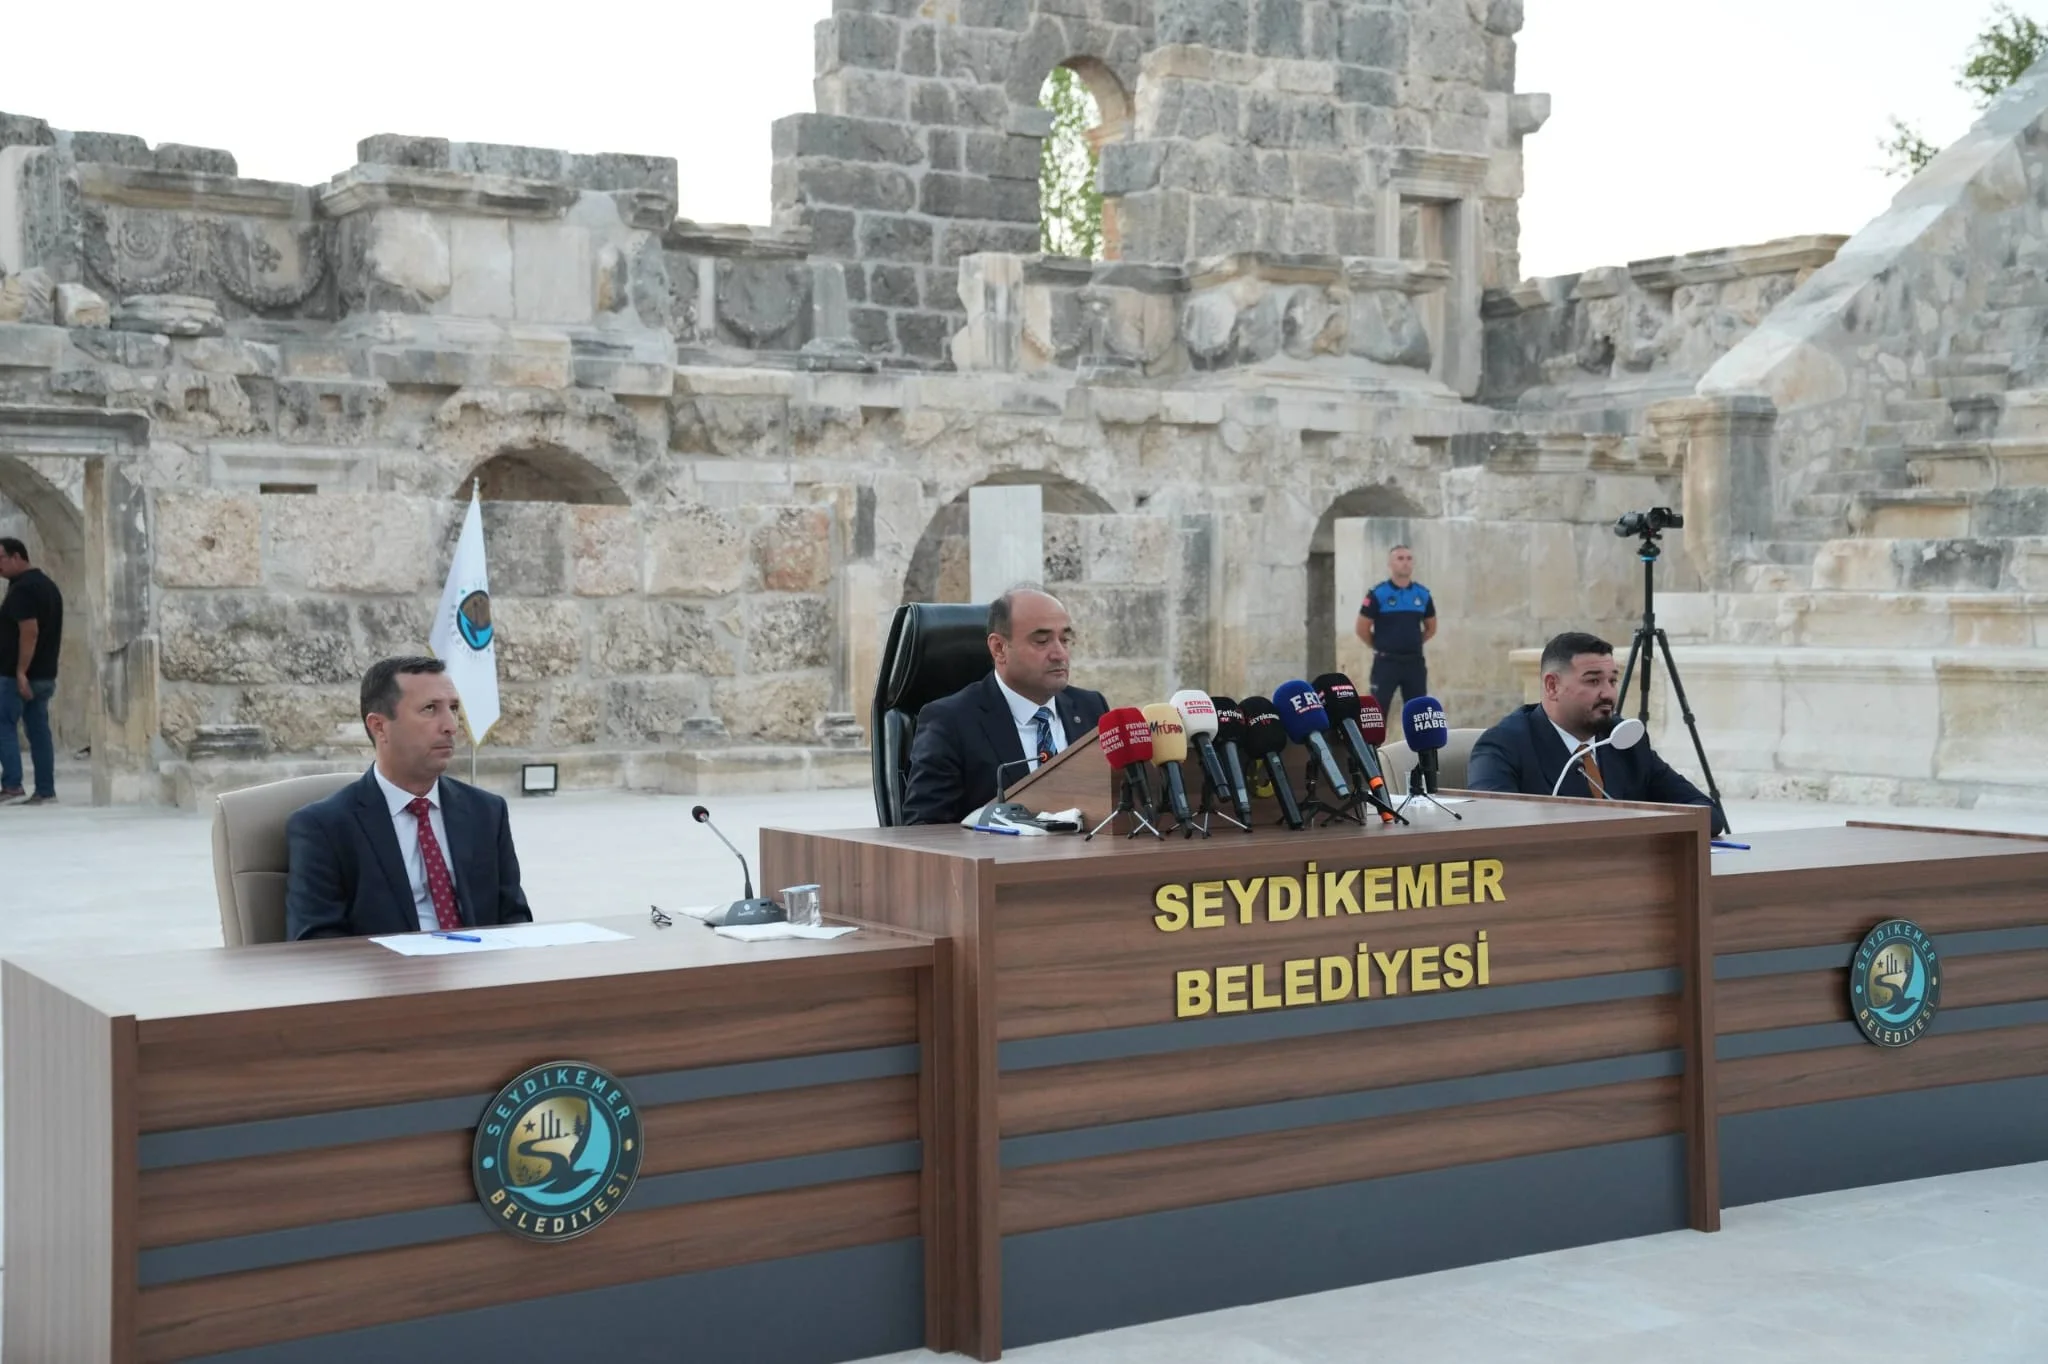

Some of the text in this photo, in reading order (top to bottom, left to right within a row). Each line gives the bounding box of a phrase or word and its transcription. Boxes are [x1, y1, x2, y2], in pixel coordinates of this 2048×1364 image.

[1154, 859, 1506, 932] SEYDİKEMER
[1177, 930, 1490, 1018] BELEDİYESİ
[487, 1068, 632, 1137] SEYDİKEMER
[490, 1172, 629, 1234] BELEDİYESİ
